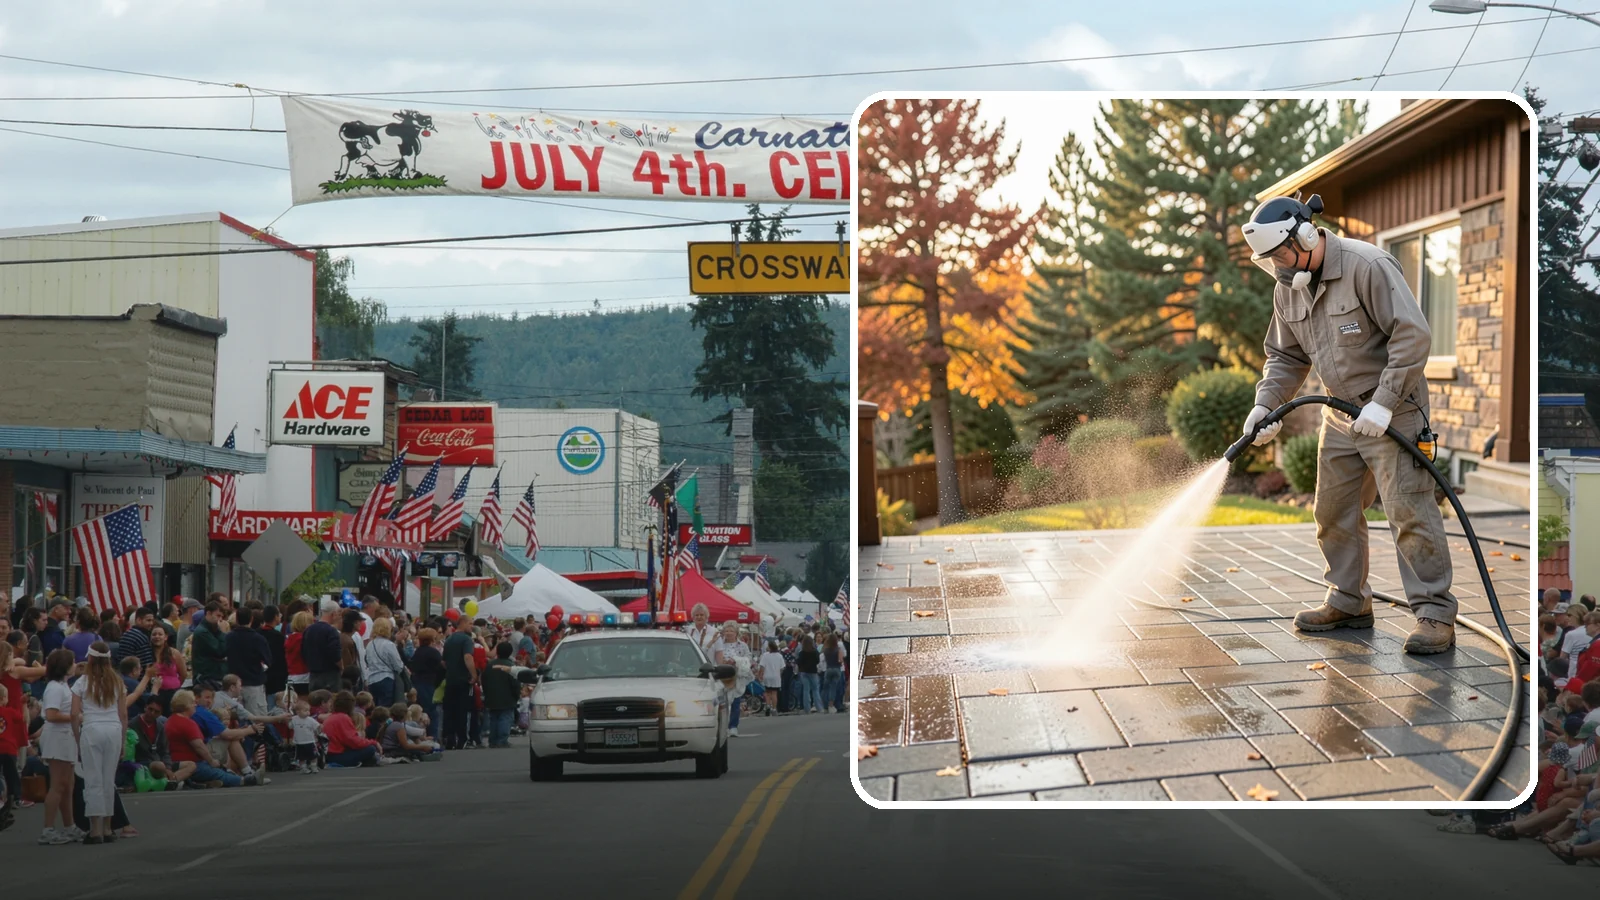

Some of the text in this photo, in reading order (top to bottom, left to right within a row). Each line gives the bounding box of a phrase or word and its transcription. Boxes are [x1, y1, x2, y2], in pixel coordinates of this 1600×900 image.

[481, 141, 604, 193] JULY
[632, 150, 746, 198] 4th.
[697, 254, 850, 280] CROSSWA
[283, 380, 373, 420] ACE
[406, 409, 485, 422] CEDAR LOG
[283, 421, 370, 436] Hardware
[416, 428, 476, 447] Coca-Cola
[96, 485, 124, 495] Vincent
[126, 486, 136, 495] de
[137, 486, 155, 495] Paul
[688, 526, 741, 535] CRNATION
[699, 535, 730, 543] GLASS
